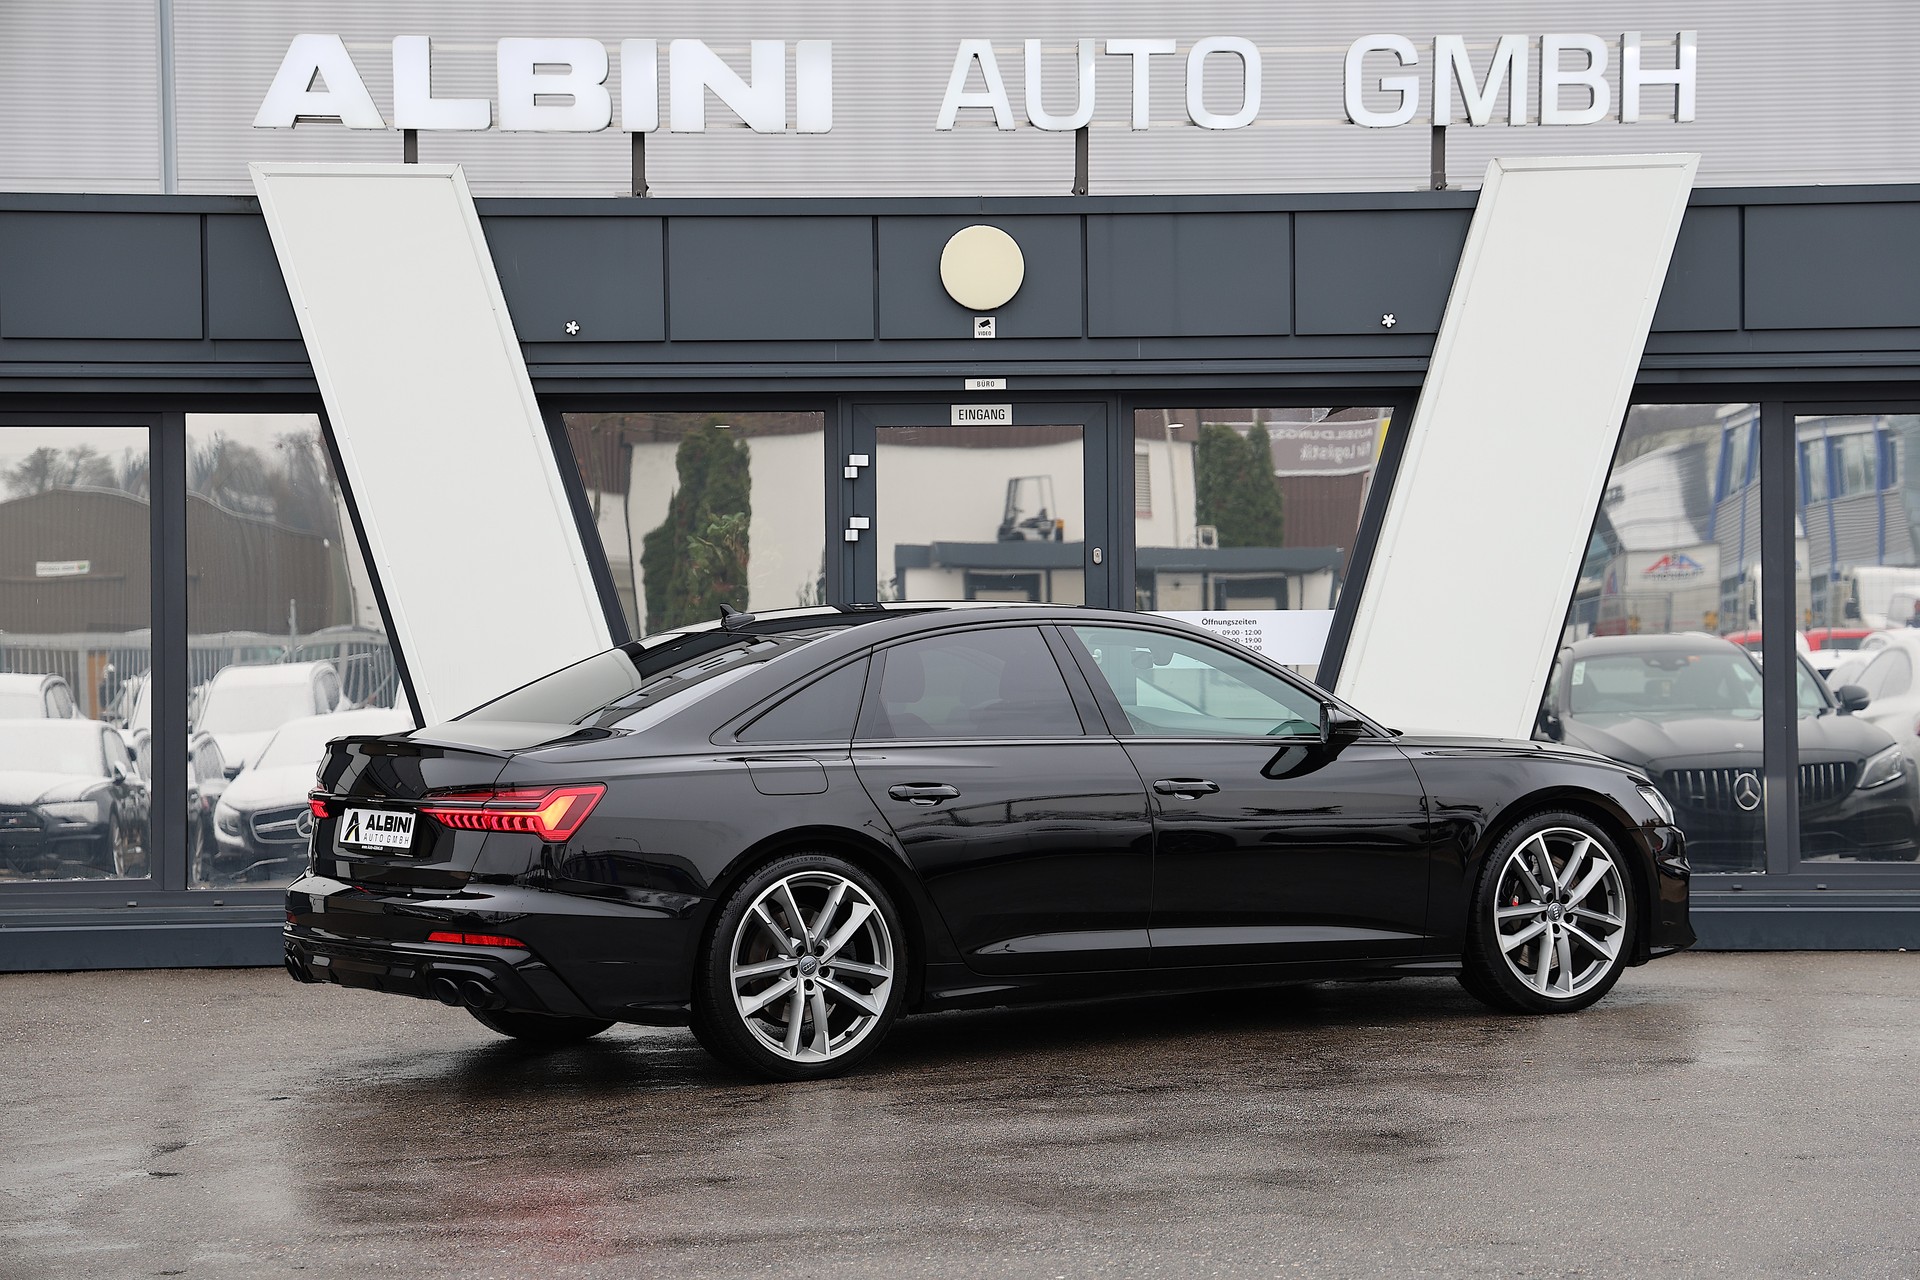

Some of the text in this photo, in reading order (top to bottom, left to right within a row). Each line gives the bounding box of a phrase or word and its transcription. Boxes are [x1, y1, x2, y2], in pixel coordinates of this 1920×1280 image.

[252, 30, 1698, 134] ALBINI AUTO GMBH
[958, 408, 1005, 420] EINGANG
[1202, 617, 1257, 626] Öffnungszeiten
[366, 814, 412, 833] ALBINI
[363, 833, 410, 845] AUTO GMBH
